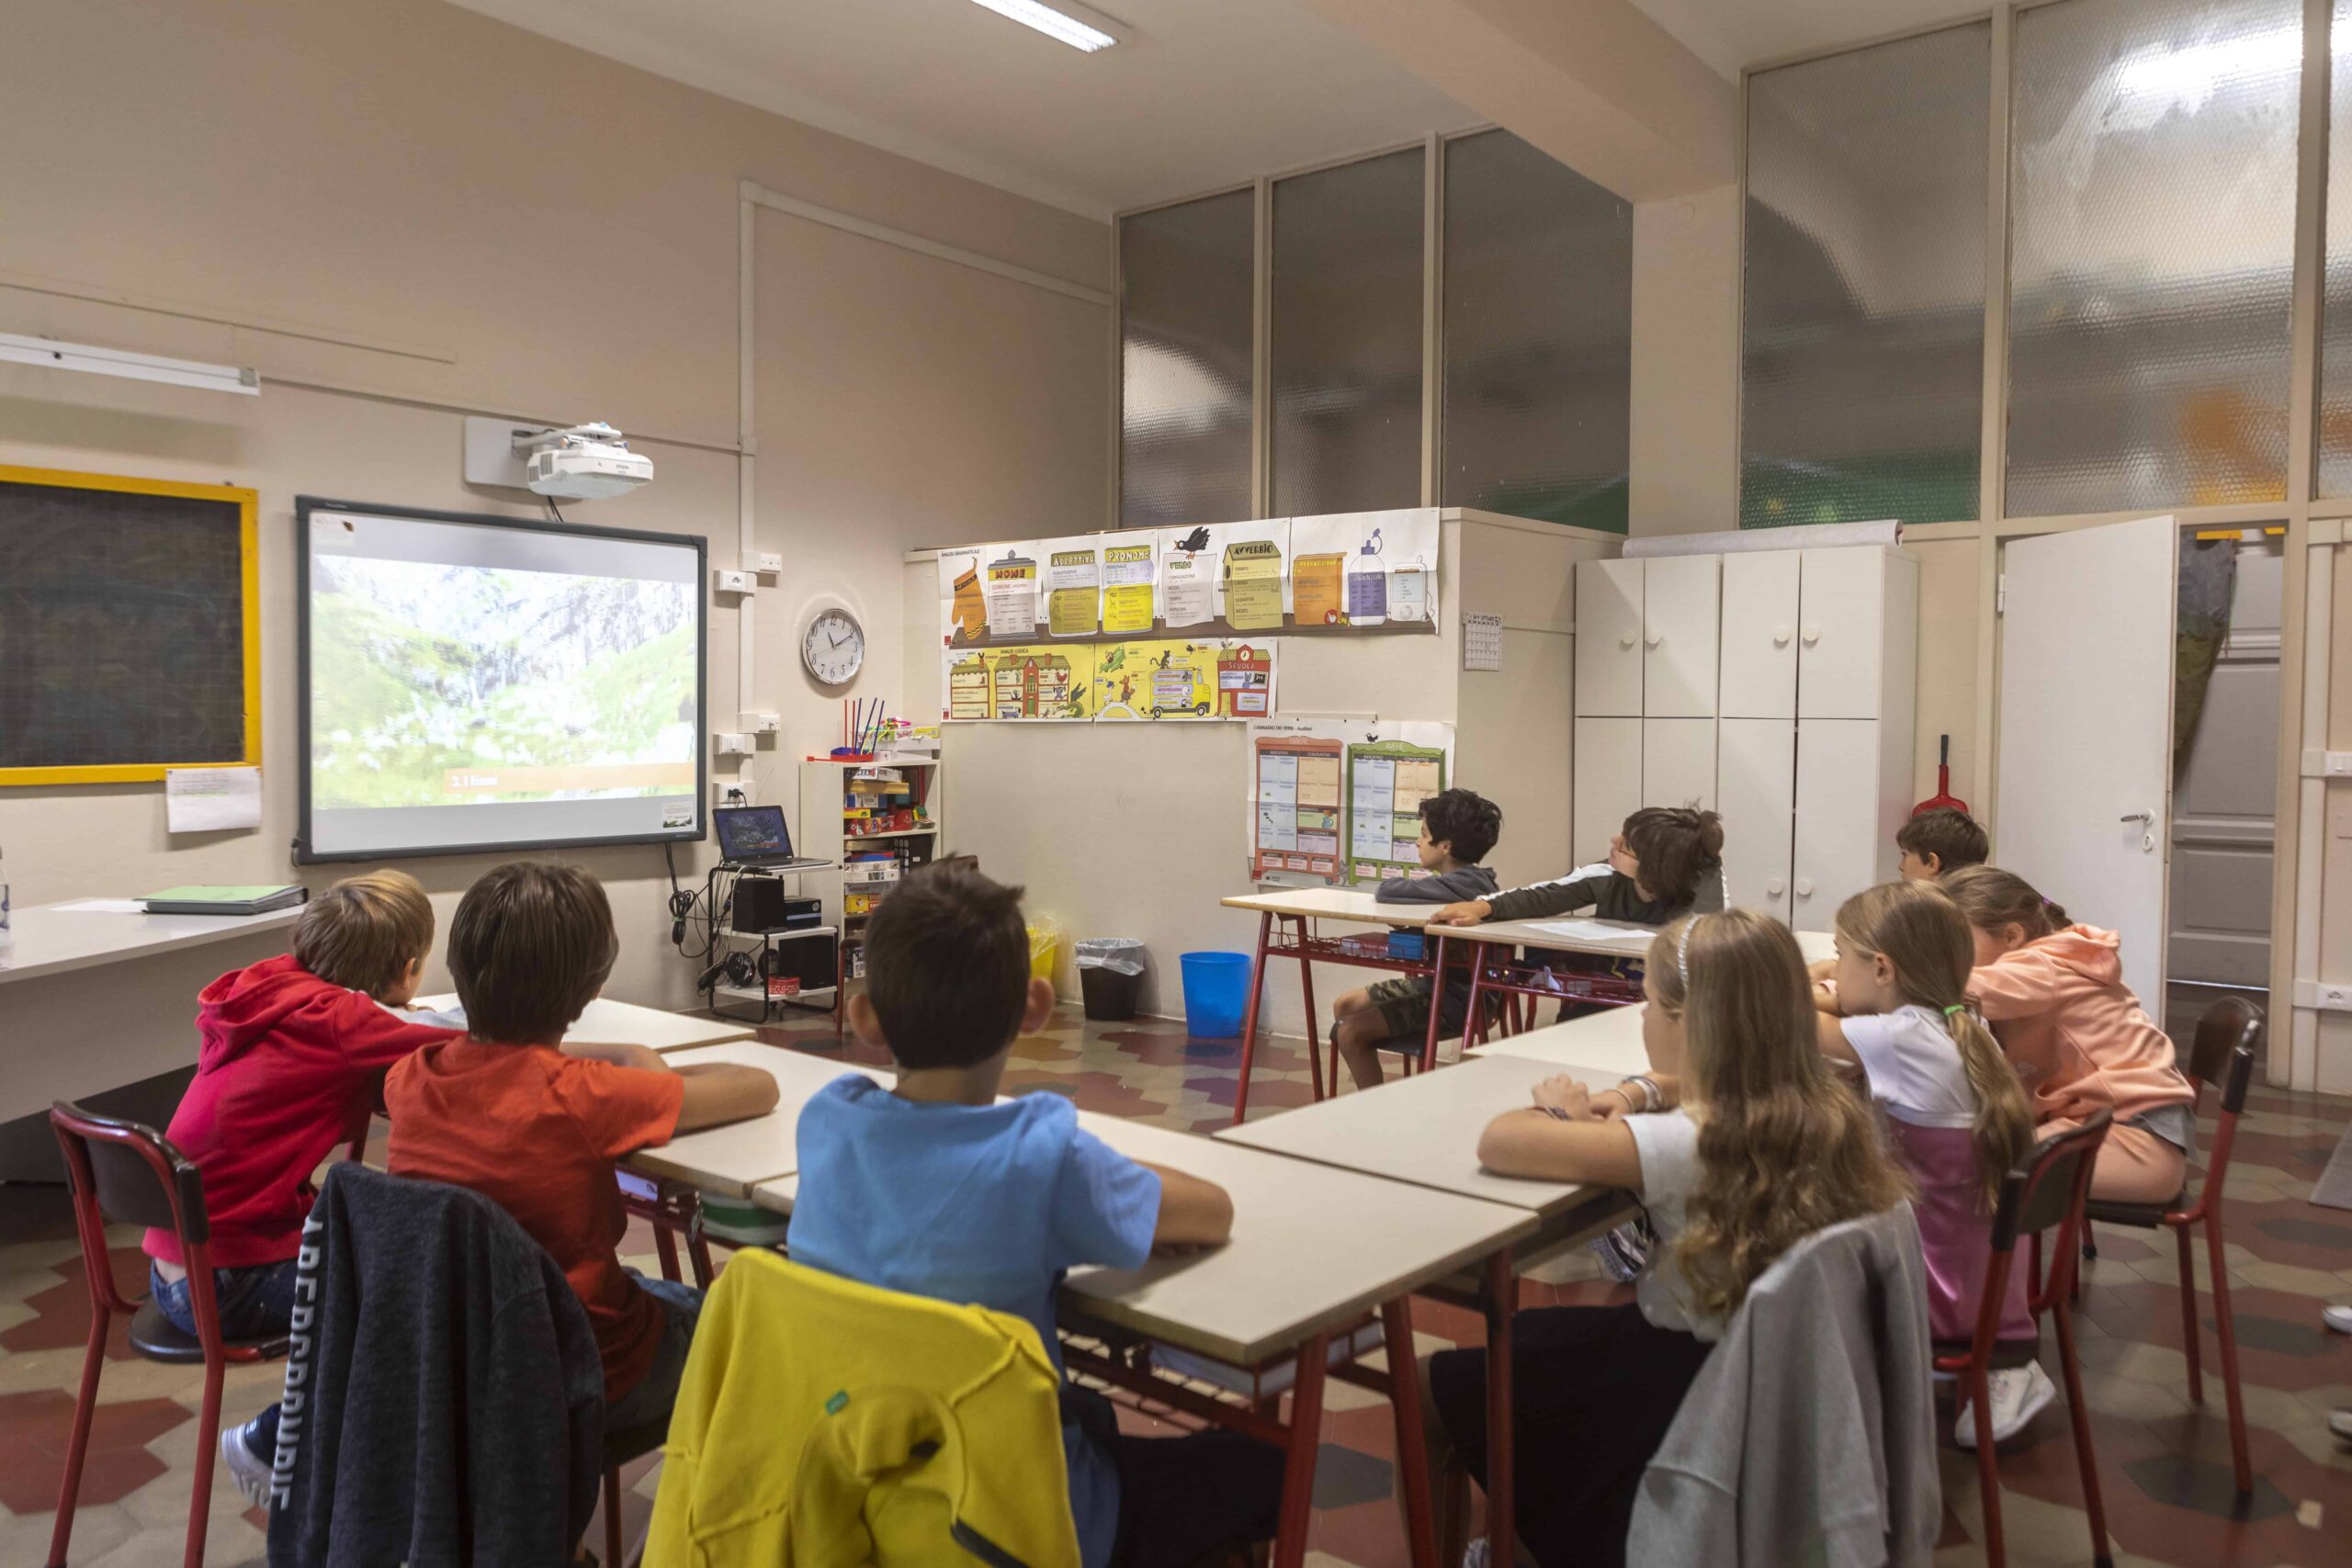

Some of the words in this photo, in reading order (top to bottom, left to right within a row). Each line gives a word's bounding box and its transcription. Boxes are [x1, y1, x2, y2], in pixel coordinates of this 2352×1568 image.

[1108, 550, 1150, 561] PRONOME
[995, 569, 1025, 580] NOME
[1228, 661, 1255, 670] SCUOLA
